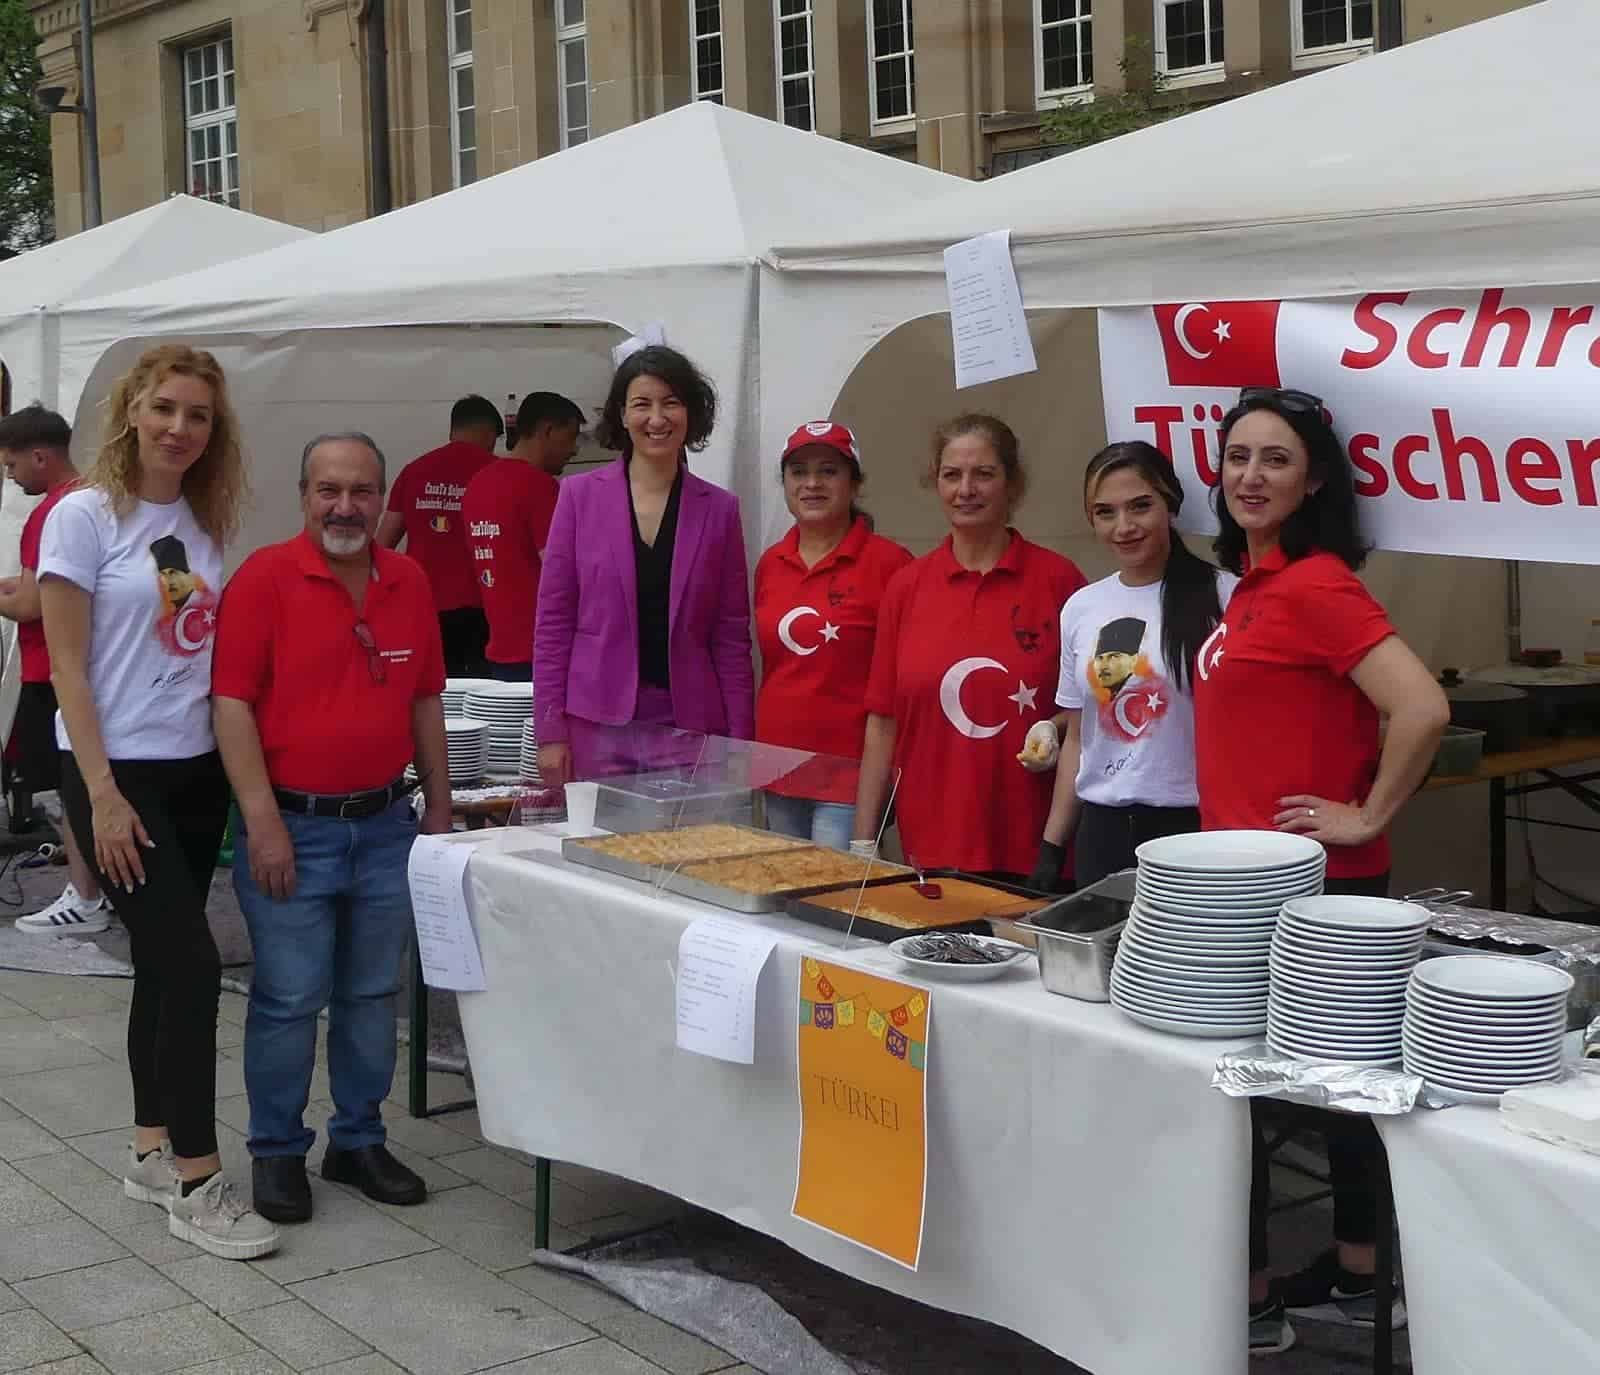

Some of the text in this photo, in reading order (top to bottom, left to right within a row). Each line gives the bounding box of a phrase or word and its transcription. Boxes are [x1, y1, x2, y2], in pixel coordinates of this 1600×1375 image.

[1340, 288, 1600, 369] Schr
[1134, 404, 1600, 507] Tüscher
[812, 1073, 901, 1131] TÜRKEI
